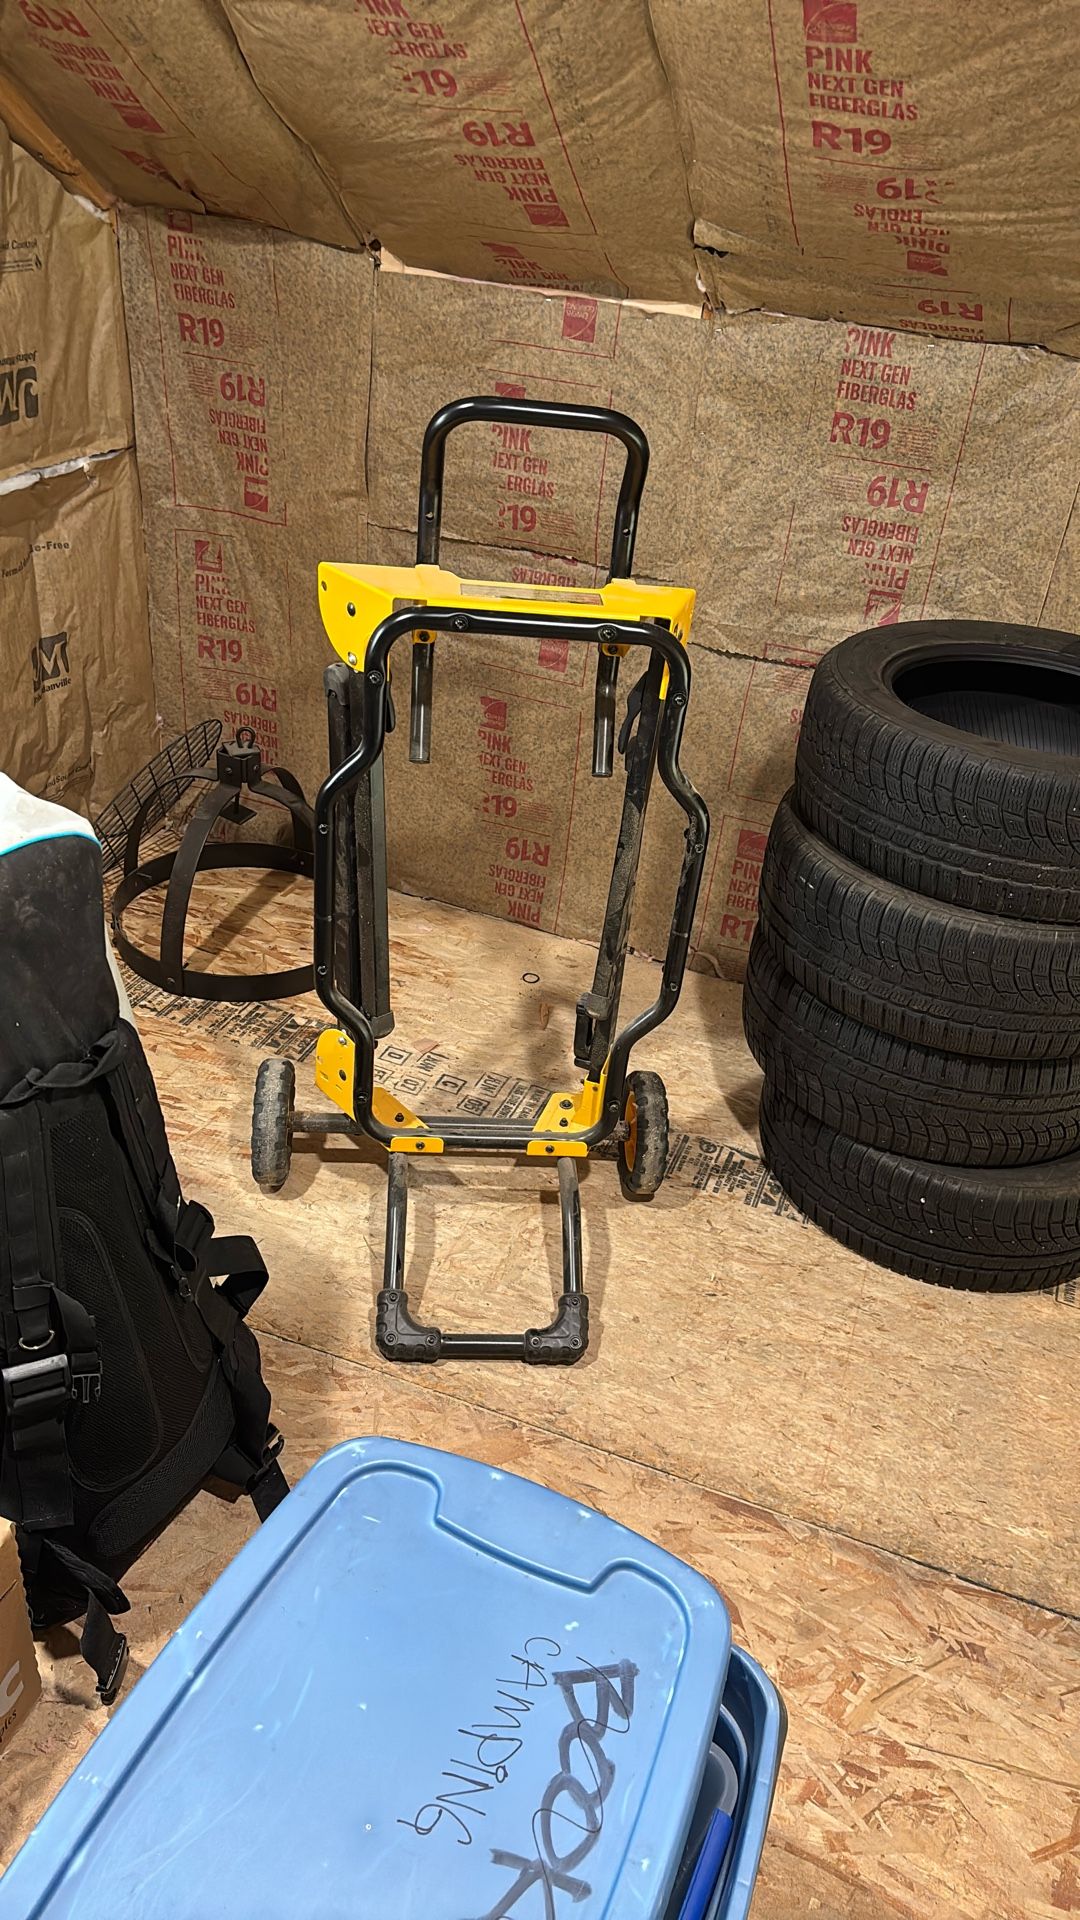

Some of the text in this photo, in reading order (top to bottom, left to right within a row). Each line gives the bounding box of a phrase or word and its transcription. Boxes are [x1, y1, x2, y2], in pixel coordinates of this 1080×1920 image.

[406, 22, 444, 40] GEN
[805, 46, 873, 74] PINK
[402, 68, 458, 97] 19
[808, 71, 904, 97] NEXT GEN
[809, 93, 919, 121] FIBERGLAS
[462, 120, 536, 147] R19
[811, 120, 892, 155] R19
[454, 154, 545, 170] FIBERGLAS
[474, 170, 551, 186] NEXT GEN
[502, 185, 558, 203] PINK
[170, 262, 225, 287] NEXT GEN
[174, 283, 236, 309] FIBERGLAS
[917, 299, 983, 321] R19
[177, 312, 225, 348] R19
[840, 358, 911, 386] NEXT GEN
[220, 371, 266, 407] R19
[836, 380, 918, 411] FIBERGLAS
[209, 408, 266, 434] FIBERGLAS
[829, 411, 891, 450] R19
[217, 430, 268, 453] NEXT GEN
[523, 456, 549, 475] GEN
[867, 475, 929, 514] R19
[841, 515, 919, 544] FIBERGLAS
[847, 538, 914, 564] NEXT GEN
[196, 595, 248, 615] NEXT GEN
[196, 611, 255, 633] FIBERGLAS
[197, 634, 243, 663] R19
[235, 682, 277, 712] R19
[223, 711, 278, 733] FIBERGLAS
[502, 755, 528, 774] GEN
[506, 836, 550, 867] R19
[489, 863, 546, 889] FIBERGLAS
[732, 860, 760, 882] PIN
[494, 881, 544, 906] NEXT GEN
[728, 878, 758, 896] NEXT
[507, 900, 541, 928] PINK
[719, 913, 754, 942] R1
